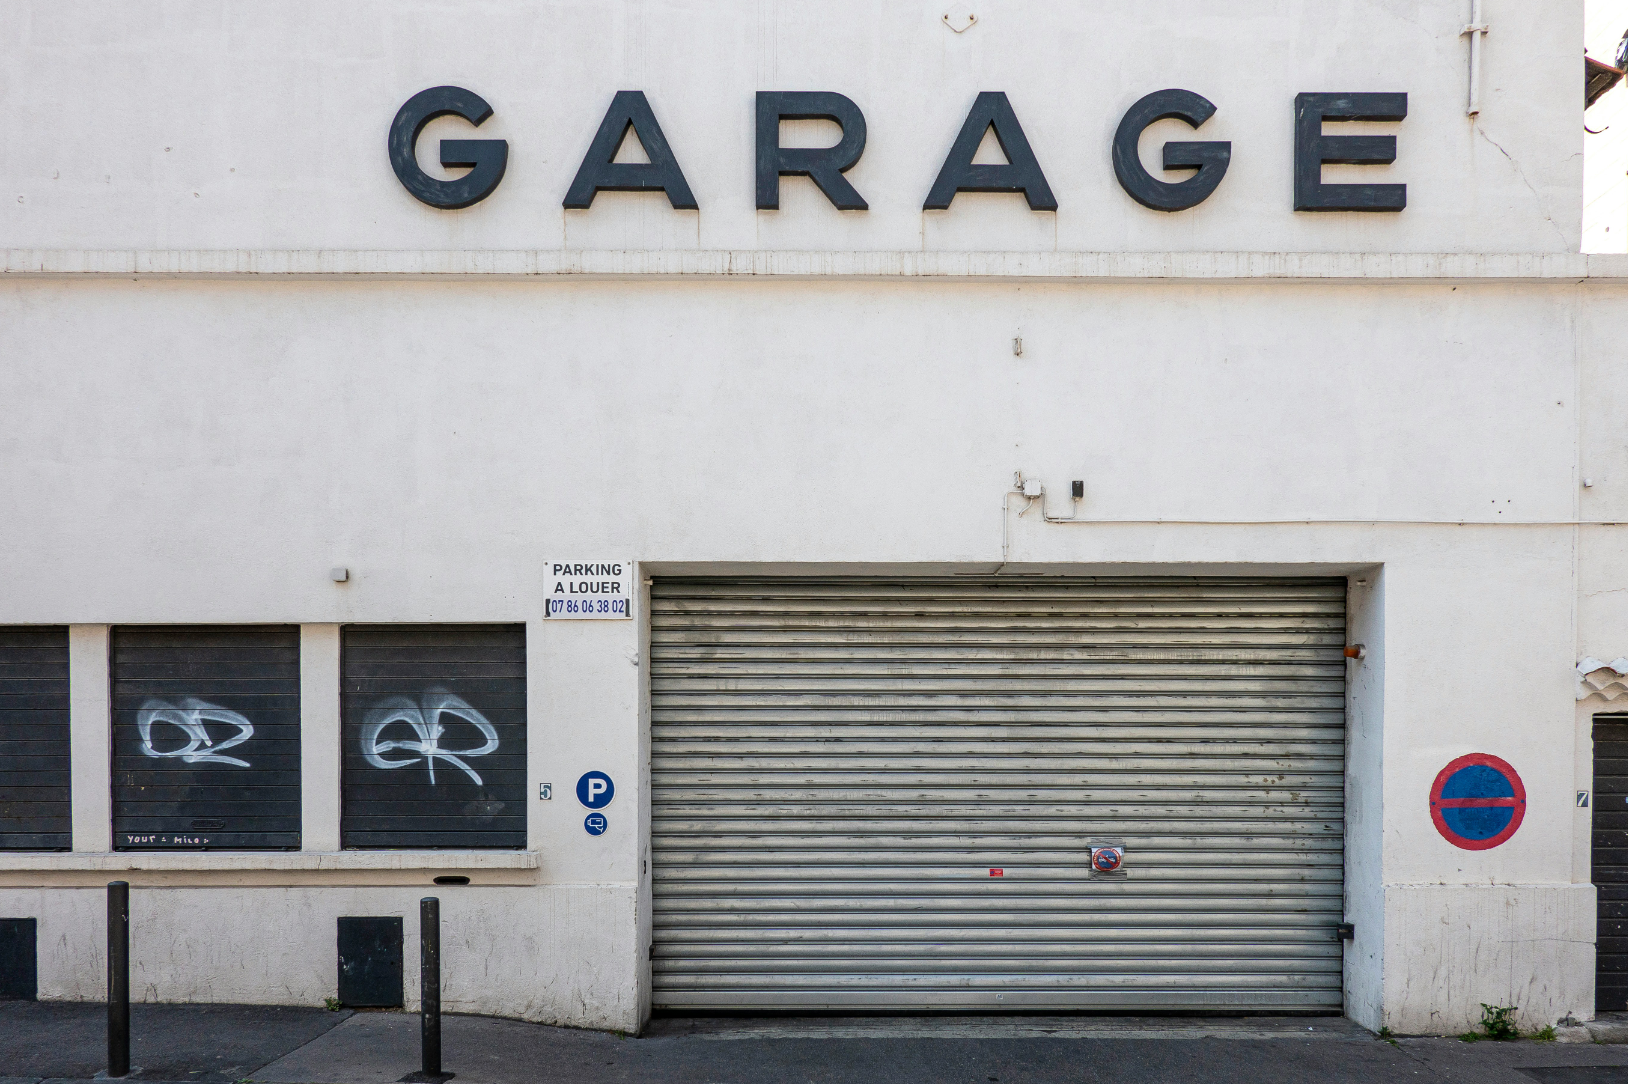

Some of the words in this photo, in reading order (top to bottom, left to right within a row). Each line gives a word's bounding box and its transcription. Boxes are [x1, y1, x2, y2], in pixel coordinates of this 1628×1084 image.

[388, 86, 1408, 212] GARAGE
[553, 563, 622, 576] PARKING
[554, 581, 565, 594] A
[569, 581, 621, 594] LOUER
[551, 599, 564, 613] 07
[566, 599, 579, 613] 86
[581, 599, 594, 613] 06
[596, 599, 609, 613] 38
[611, 599, 625, 613] 02
[540, 783, 551, 800] 5
[588, 778, 608, 802] P
[1577, 791, 1588, 807] 7
